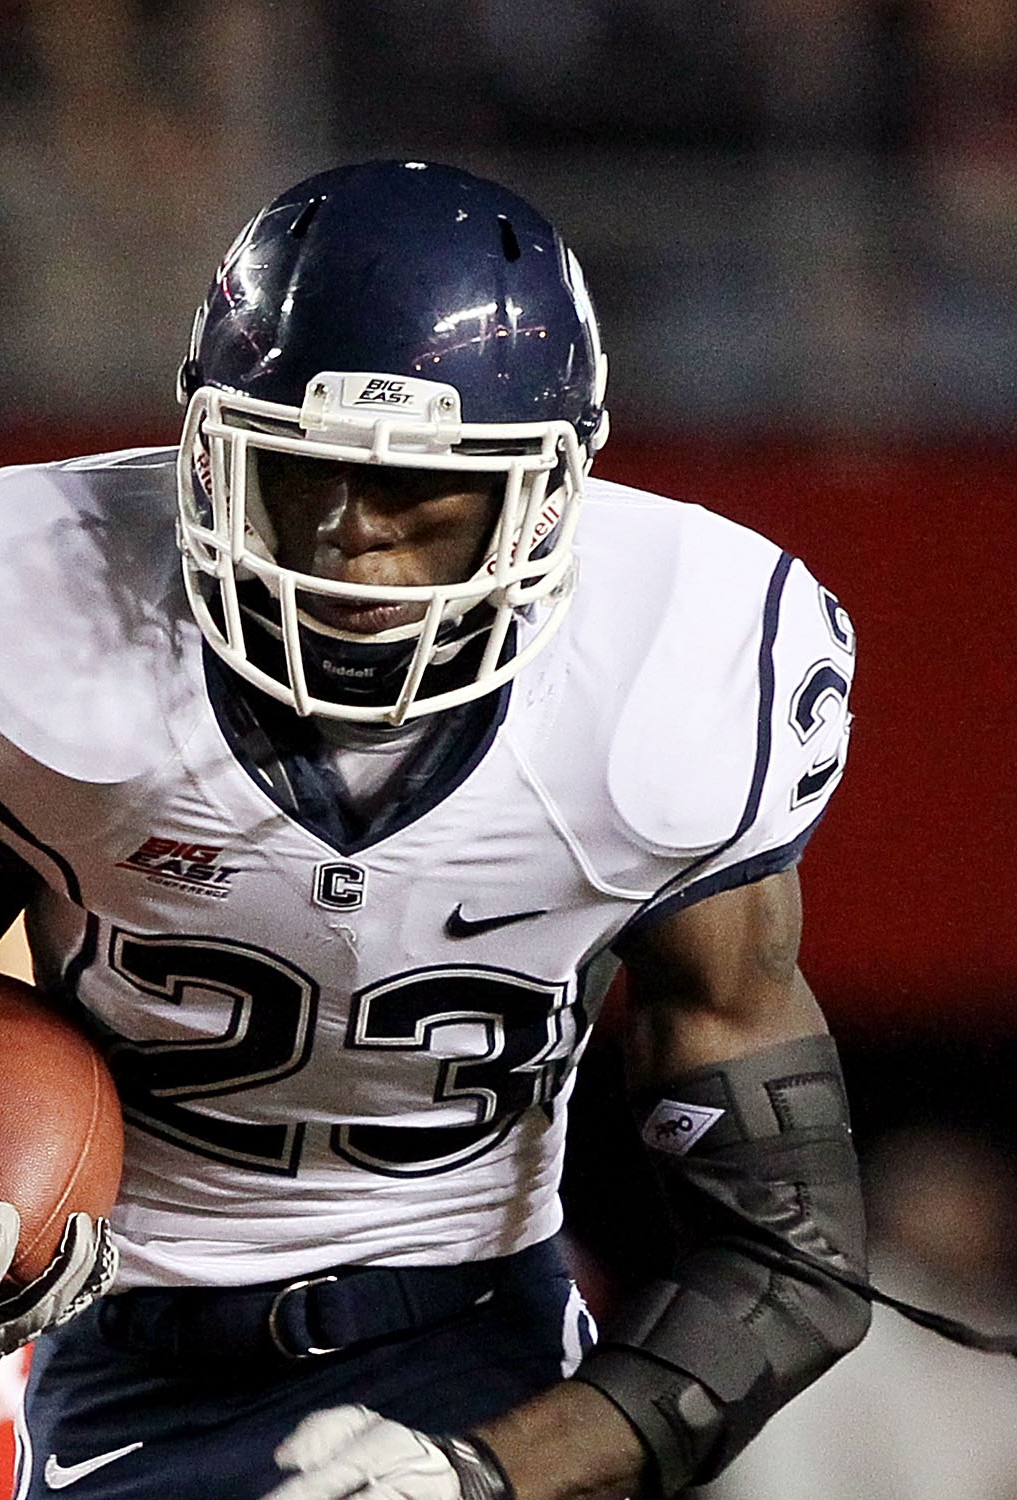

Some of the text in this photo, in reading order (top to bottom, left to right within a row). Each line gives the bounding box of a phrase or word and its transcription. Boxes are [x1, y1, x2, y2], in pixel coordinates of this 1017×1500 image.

[359, 390, 415, 404] EAST
[366, 378, 406, 392] BIG
[322, 659, 376, 678] Riddell
[138, 836, 224, 865] BIG
[125, 850, 241, 885] EAST
[146, 875, 230, 899] CONFERENCE
[319, 863, 365, 911] C
[109, 925, 569, 1178] 23
